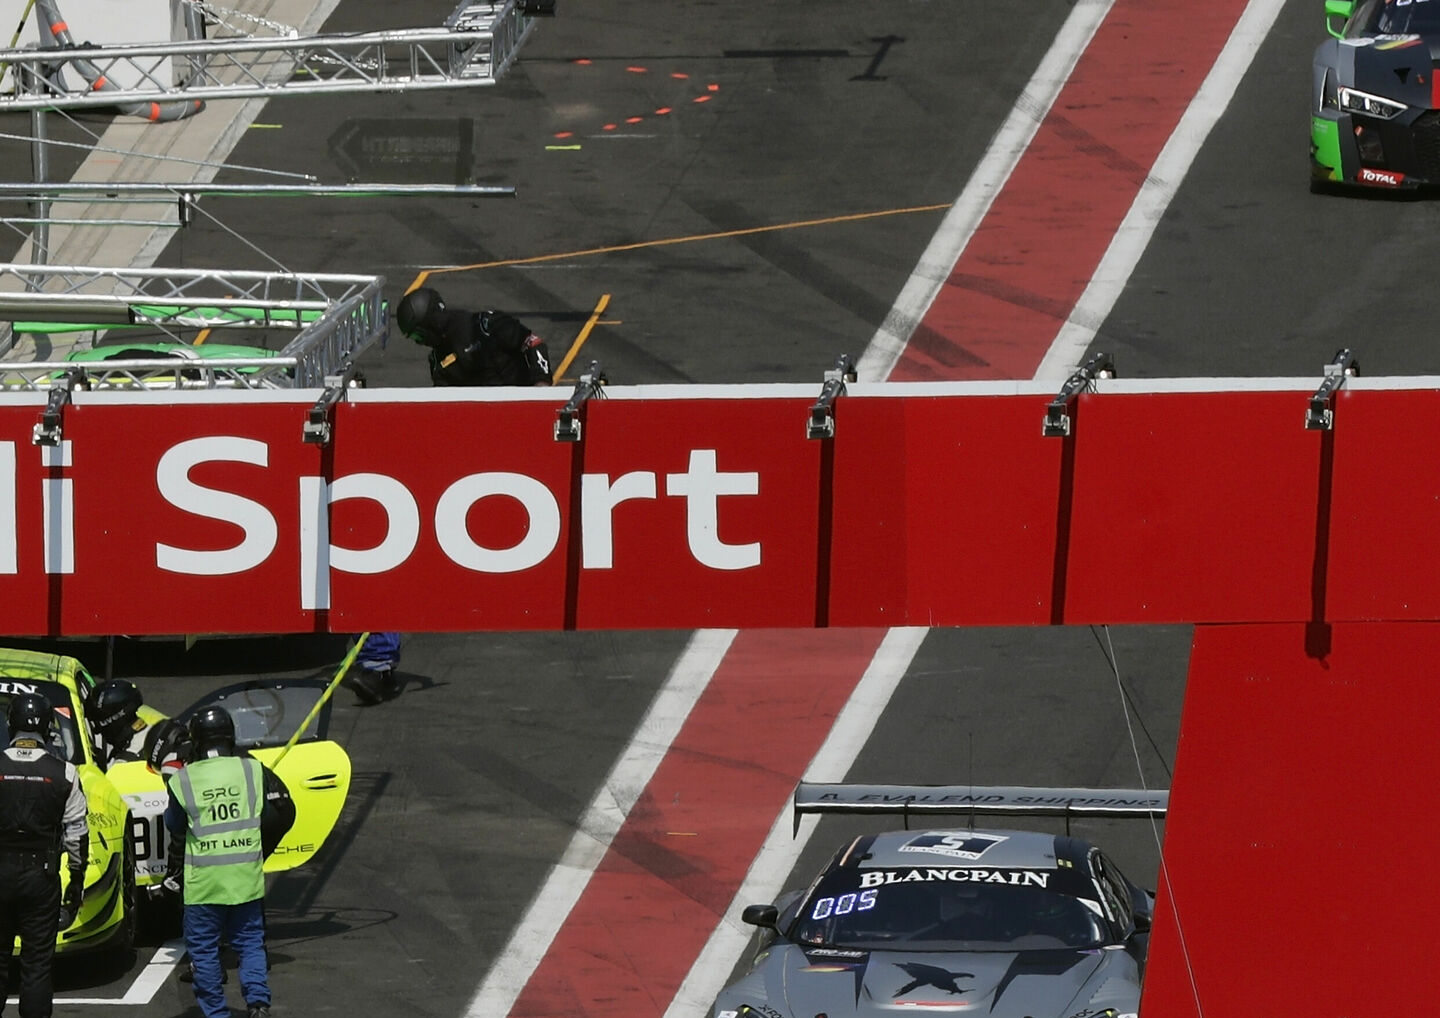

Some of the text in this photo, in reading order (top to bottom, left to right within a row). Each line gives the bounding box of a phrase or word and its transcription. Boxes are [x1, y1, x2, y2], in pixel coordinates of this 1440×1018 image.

[1362, 169, 1397, 185] TOTAL
[155, 436, 762, 611] Sport
[208, 803, 241, 821] 106
[200, 838, 253, 851] PIT LANE
[859, 869, 1050, 889] BLANCPAIN
[813, 889, 879, 920] 005
